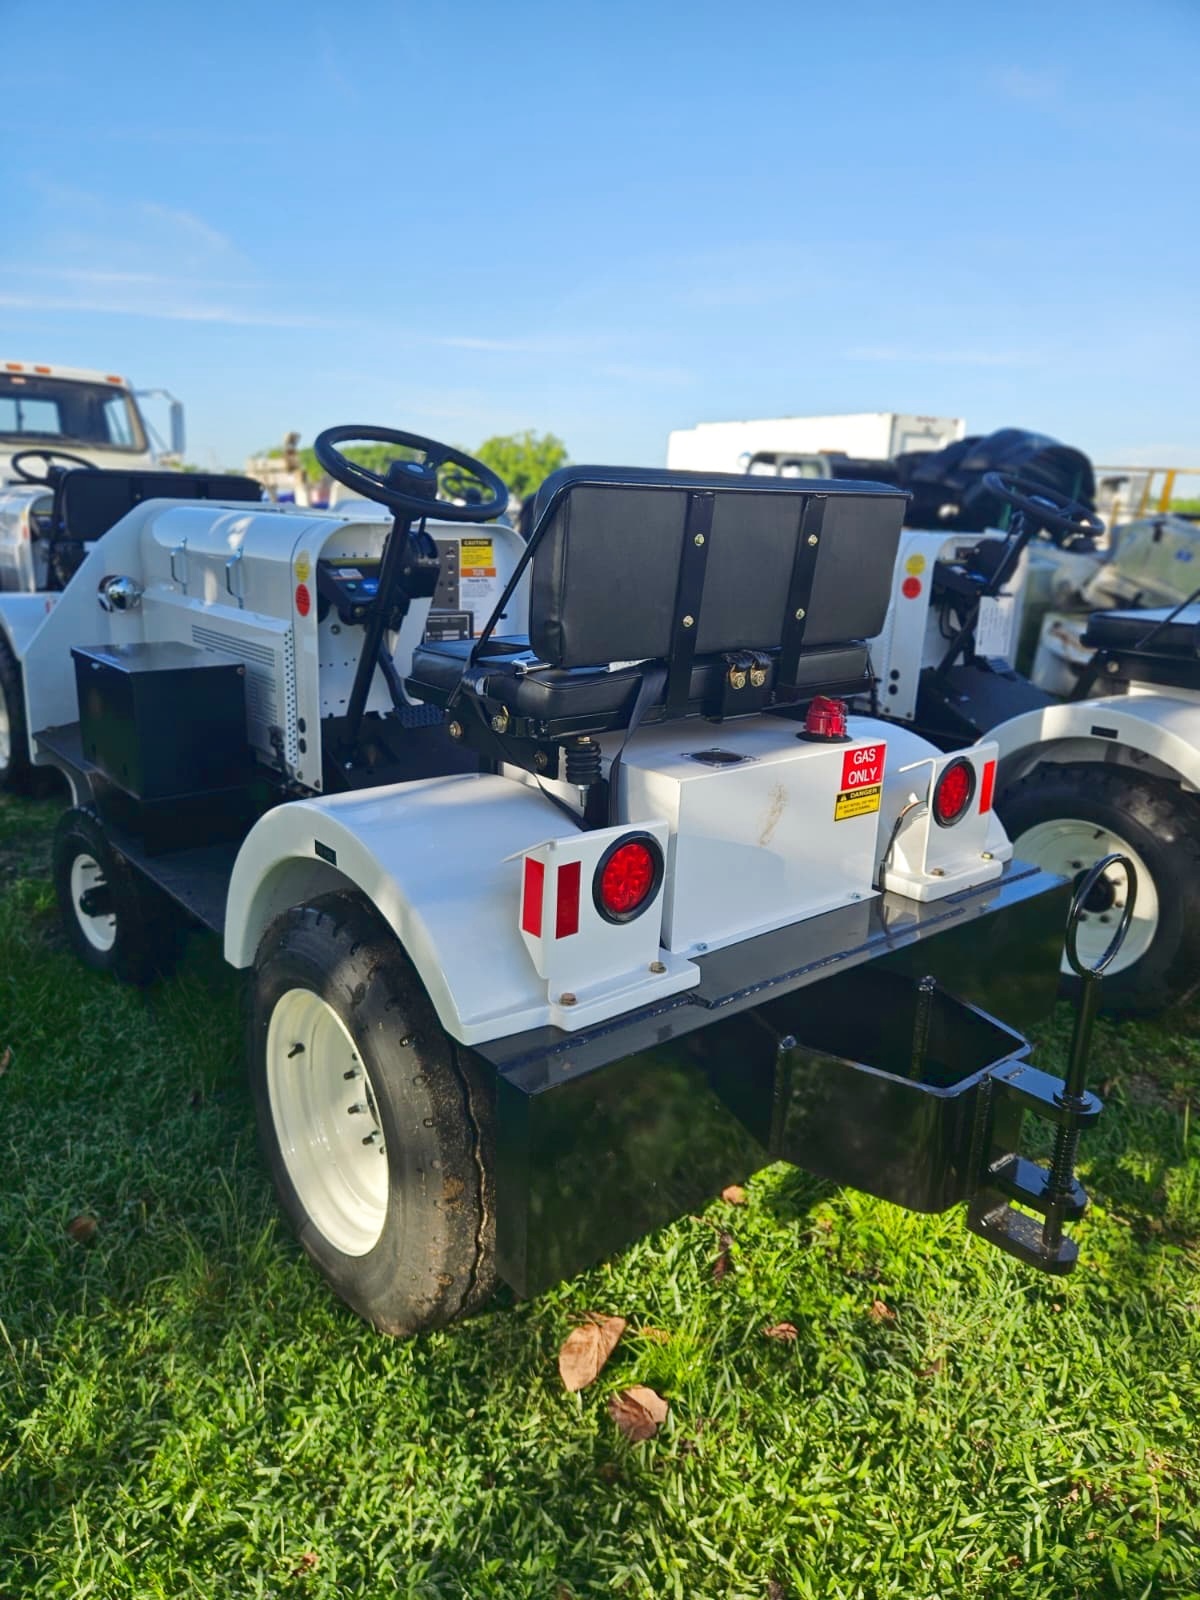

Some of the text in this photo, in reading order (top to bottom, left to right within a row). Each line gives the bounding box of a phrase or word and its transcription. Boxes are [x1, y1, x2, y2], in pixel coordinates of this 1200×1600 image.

[854, 748, 876, 764] GAS
[848, 767, 878, 784] ONLY
[850, 788, 878, 798] DANGER
